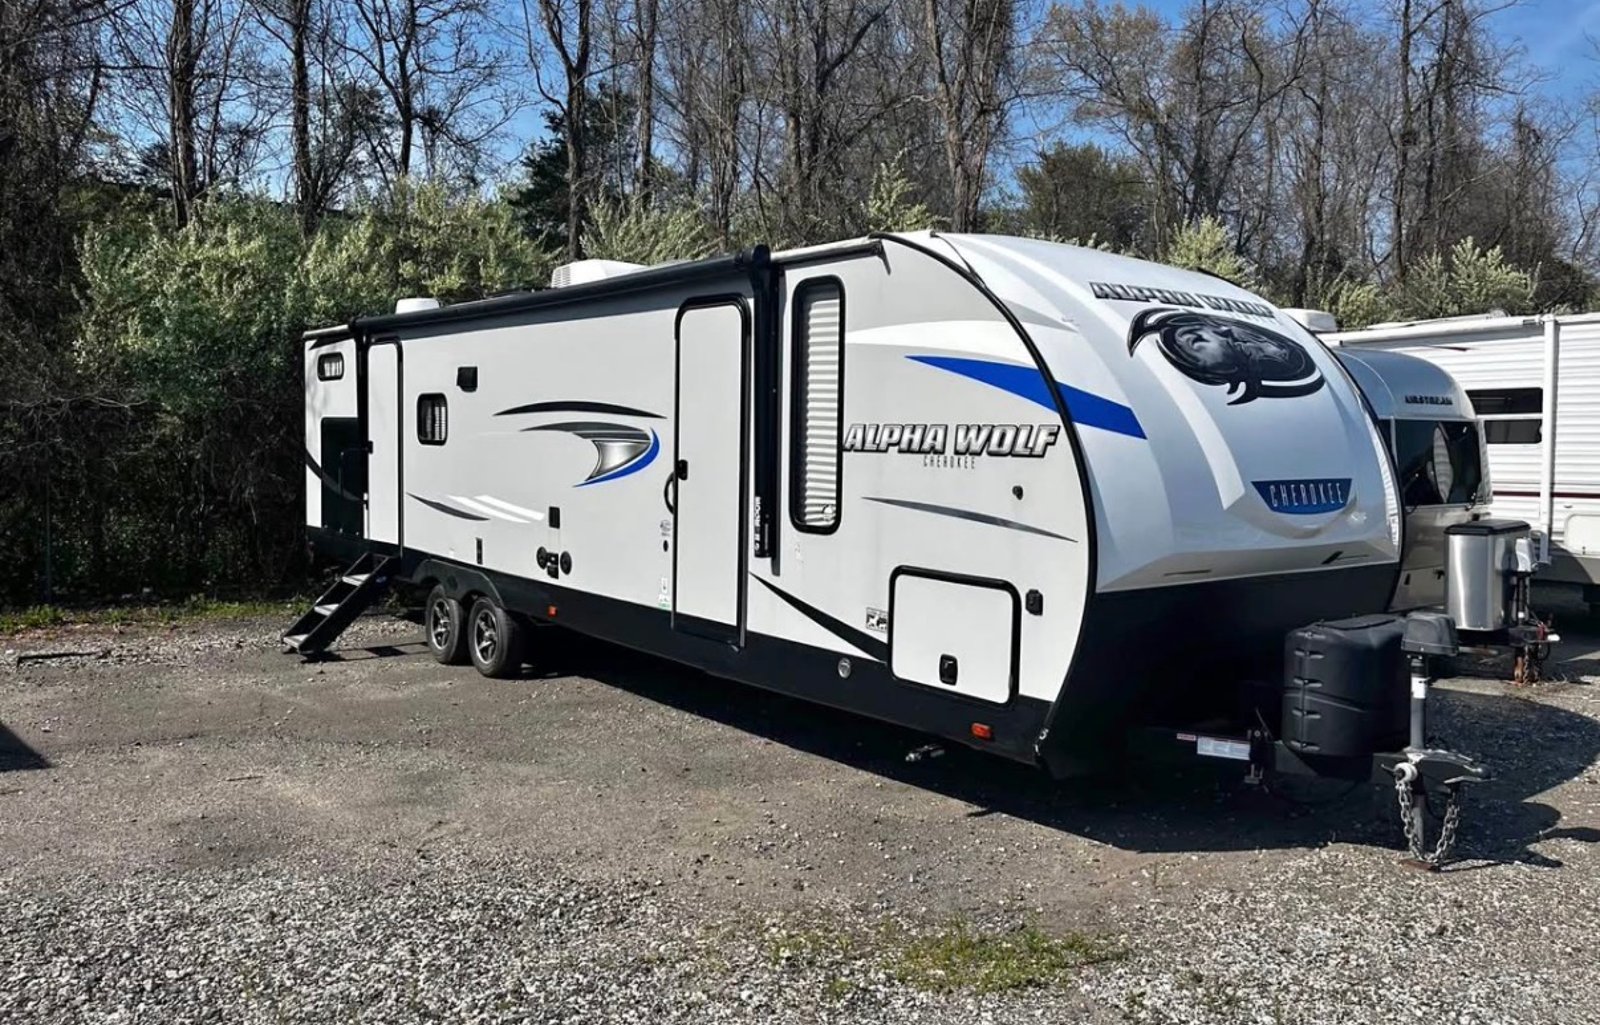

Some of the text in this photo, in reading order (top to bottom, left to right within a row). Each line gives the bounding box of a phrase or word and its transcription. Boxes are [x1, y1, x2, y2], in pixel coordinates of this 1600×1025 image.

[1089, 281, 1204, 308] ALPHA
[842, 424, 1060, 458] ALPHA WOLF
[923, 455, 976, 469] CHEROKEE
[1269, 482, 1344, 507] CHEROKEE
